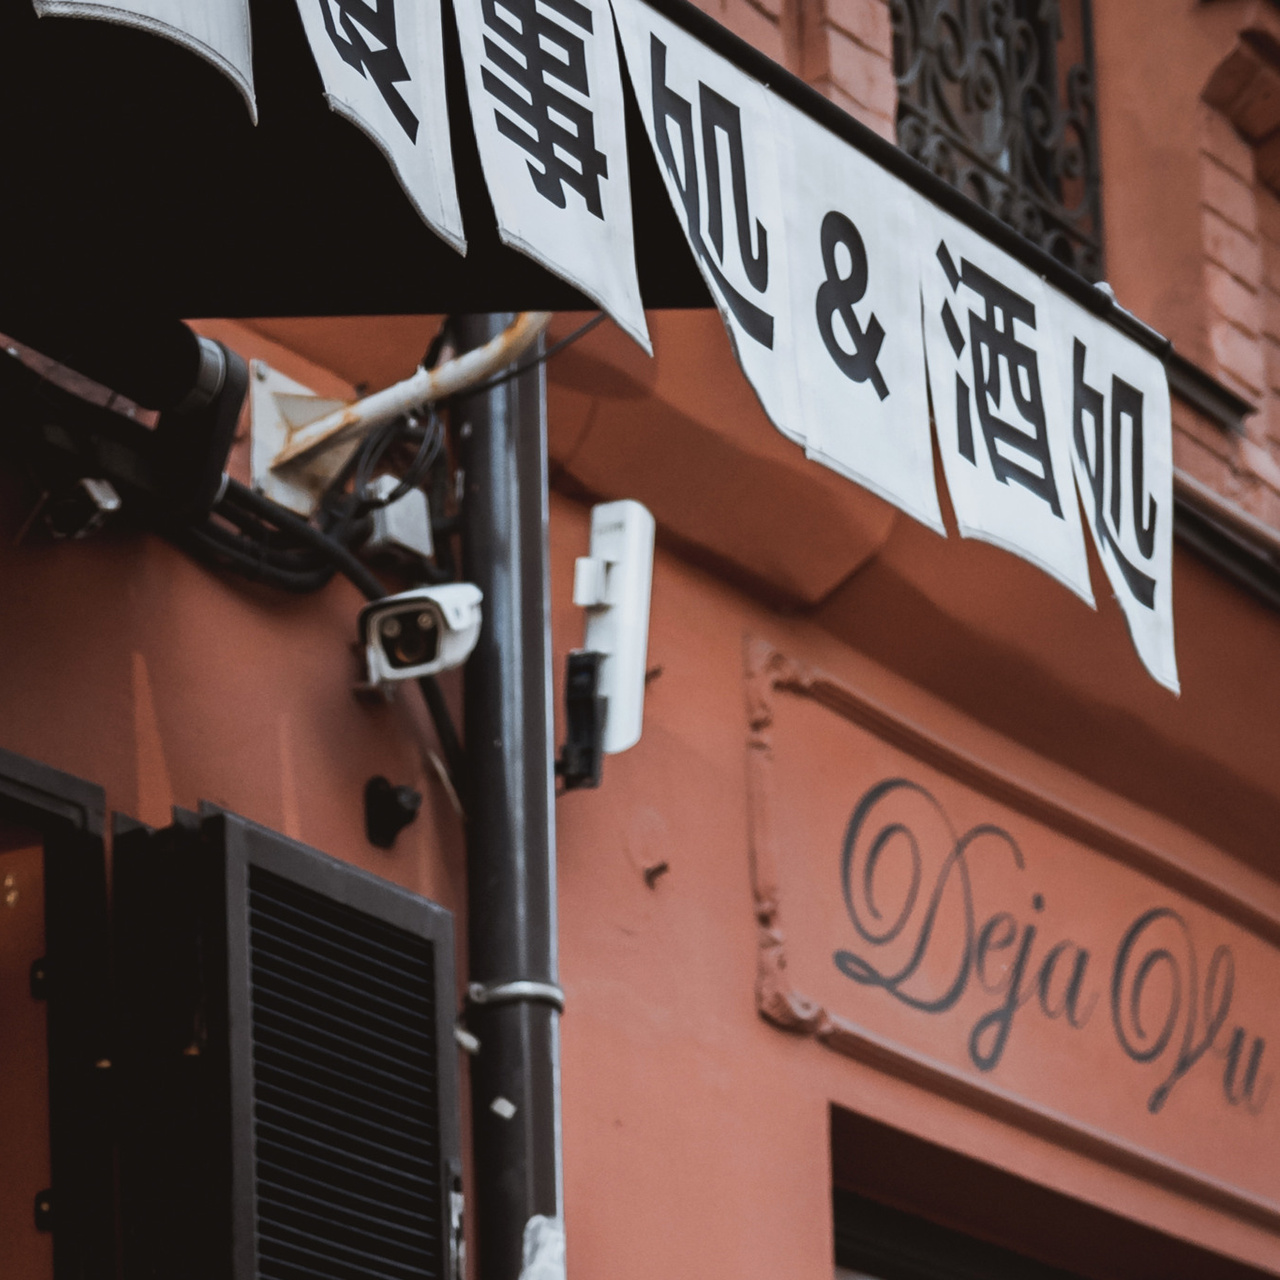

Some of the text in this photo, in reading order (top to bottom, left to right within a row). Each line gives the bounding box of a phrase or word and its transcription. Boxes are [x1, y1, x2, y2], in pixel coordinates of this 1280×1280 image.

[815, 210, 891, 403] &
[935, 239, 1158, 611] 酒処
[833, 776, 1272, 1115] Deja Vu
